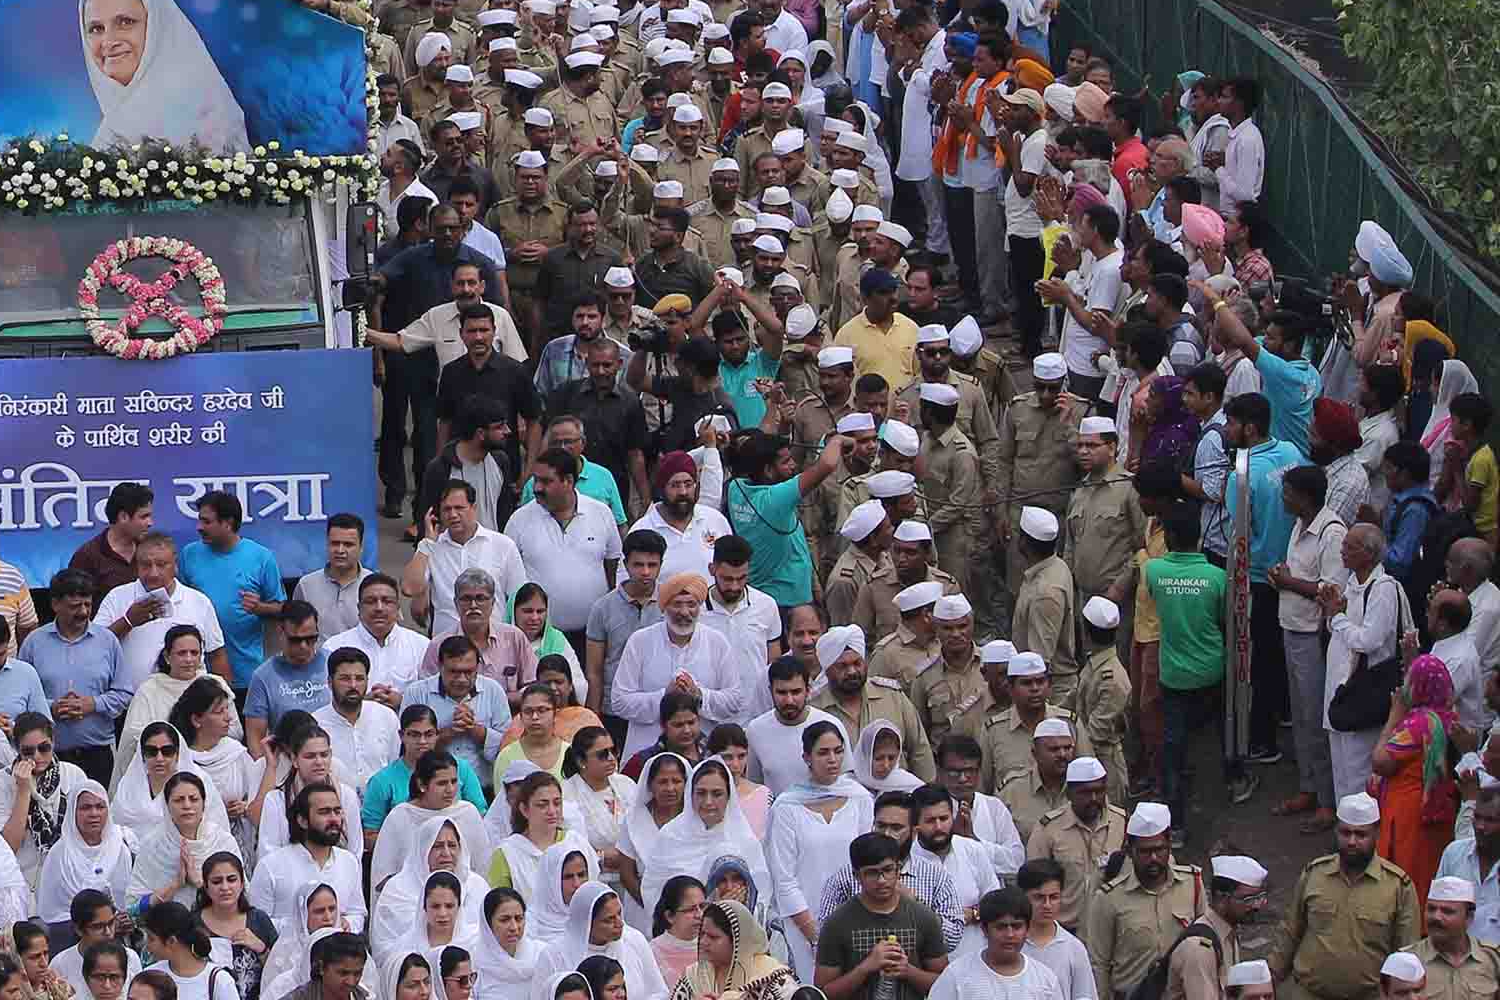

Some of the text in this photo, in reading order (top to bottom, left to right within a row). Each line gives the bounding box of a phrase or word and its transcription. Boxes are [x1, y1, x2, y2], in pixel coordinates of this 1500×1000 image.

[76, 397, 115, 414] माता
[123, 390, 194, 413] सविन्दर
[201, 387, 253, 412] हरदेव
[260, 385, 285, 409] जी
[55, 420, 227, 448] के पार्थिव शरीर की
[1156, 577, 1209, 587] NIRANKARI
[1166, 586, 1200, 595] STUDIO
